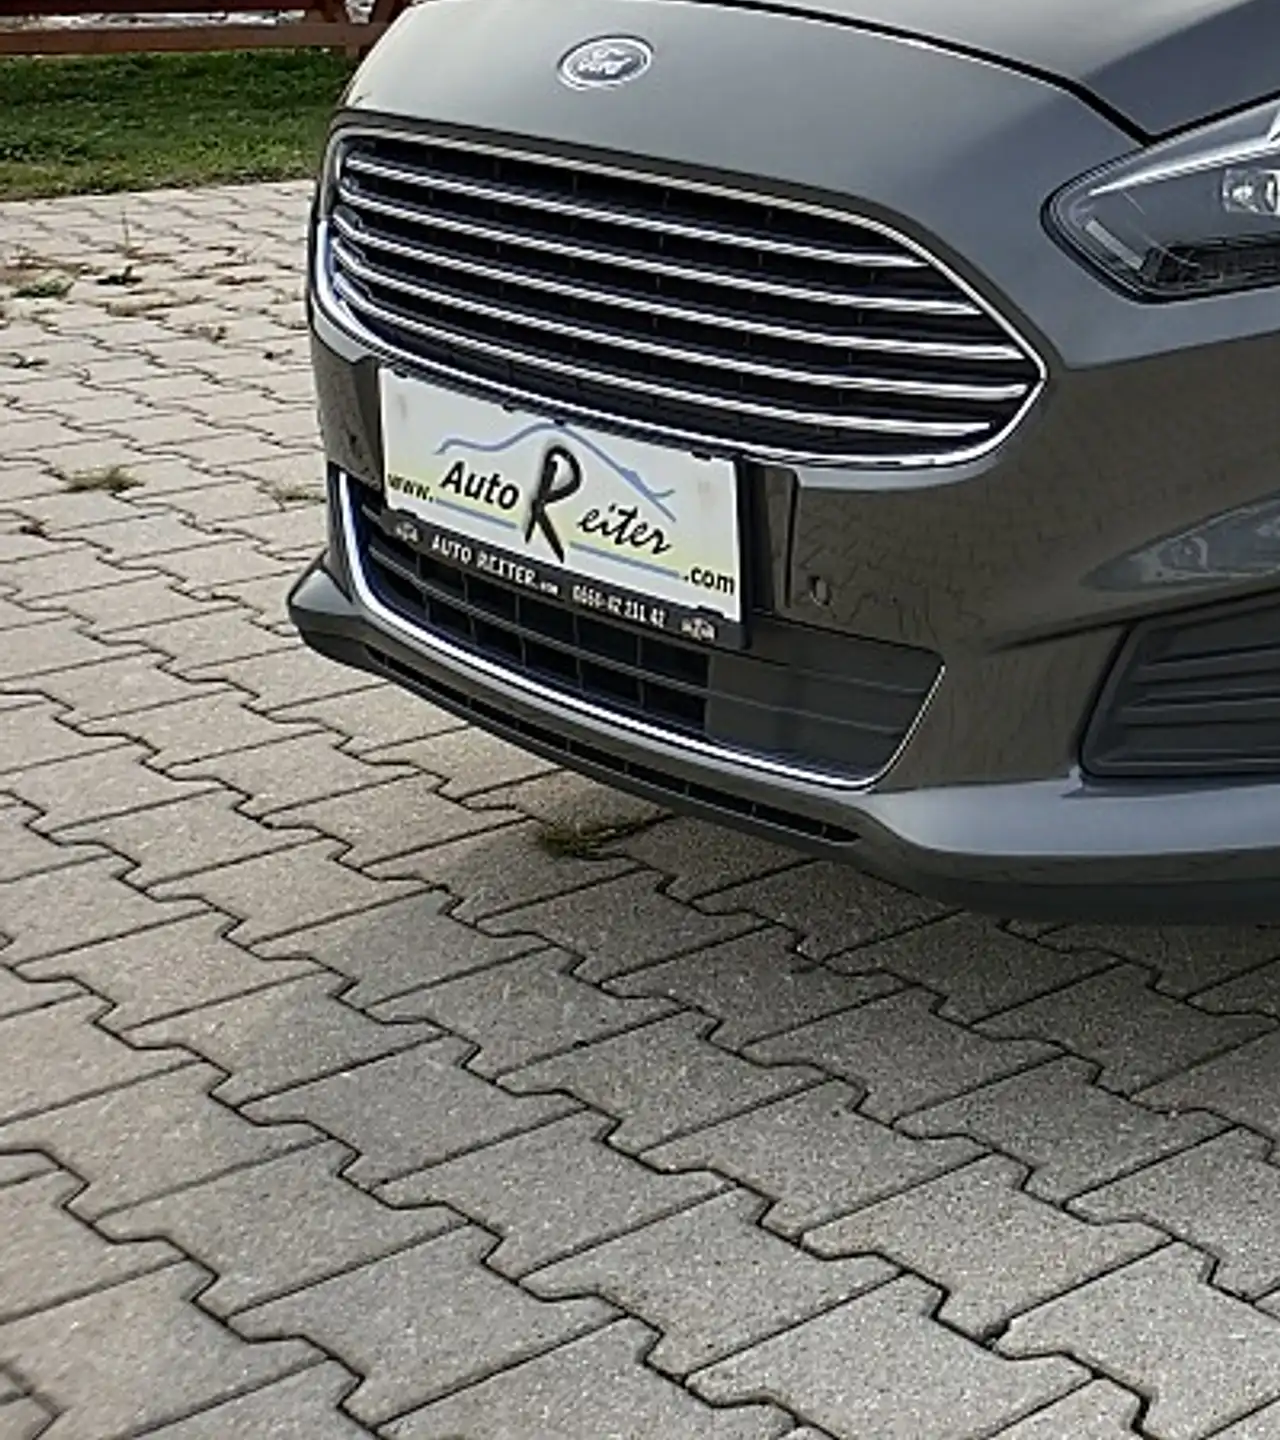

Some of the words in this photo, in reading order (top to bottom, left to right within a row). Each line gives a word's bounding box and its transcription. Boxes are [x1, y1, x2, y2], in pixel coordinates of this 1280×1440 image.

[387, 472, 434, 503] www.
[684, 567, 735, 595] .com
[432, 534, 472, 564] AUTO
[441, 461, 519, 510] Auto
[525, 445, 671, 564] Reiter
